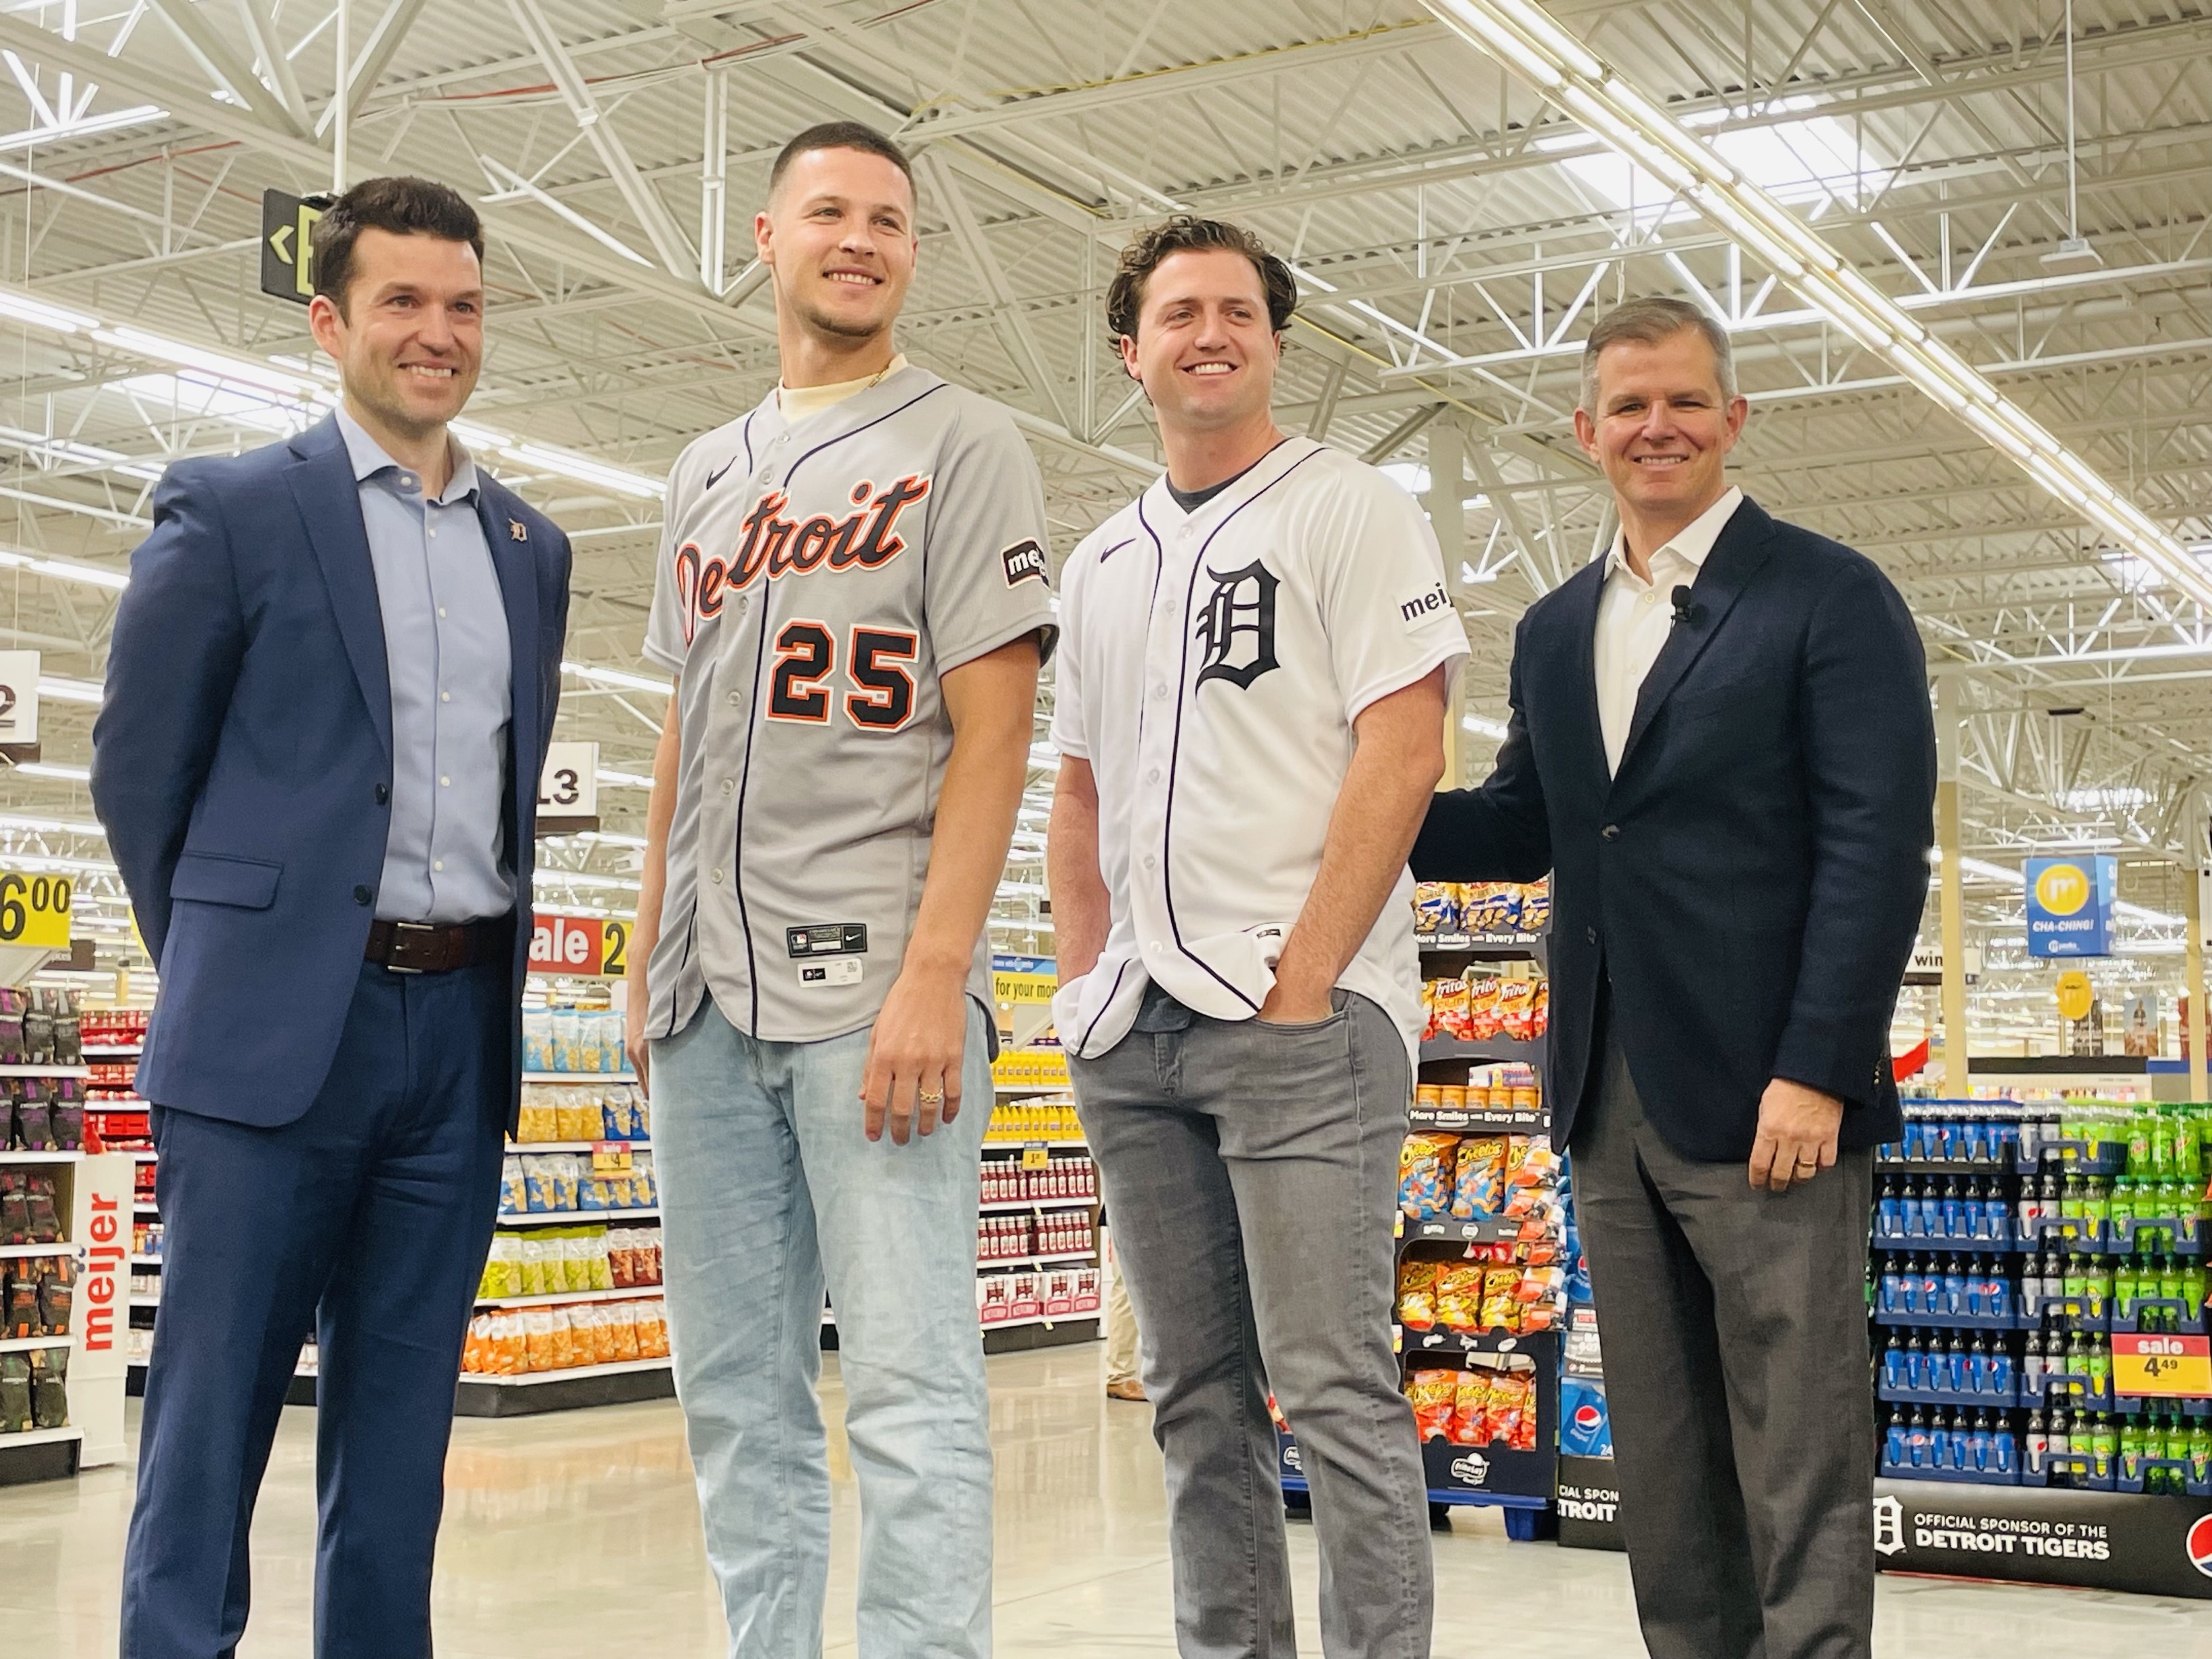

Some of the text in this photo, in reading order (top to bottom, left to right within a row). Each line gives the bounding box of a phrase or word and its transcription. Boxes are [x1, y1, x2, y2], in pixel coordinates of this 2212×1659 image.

[678, 472, 932, 651] Detroit
[764, 618, 920, 733] 25
[2032, 918, 2095, 933] CHA-CHING!
[604, 922, 625, 975] 2
[996, 977, 1010, 996] for
[1013, 982, 1034, 1000] your
[1471, 980, 1497, 1000] Frito
[78, 1193, 125, 1351] meijer
[2137, 1337, 2184, 1355] sale
[1557, 1499, 1618, 1522] TROIT
[1914, 1513, 2107, 1538] OFFICIAL SPONSOR OF THE
[1915, 1528, 2110, 1560] DETROIT TIGERS
